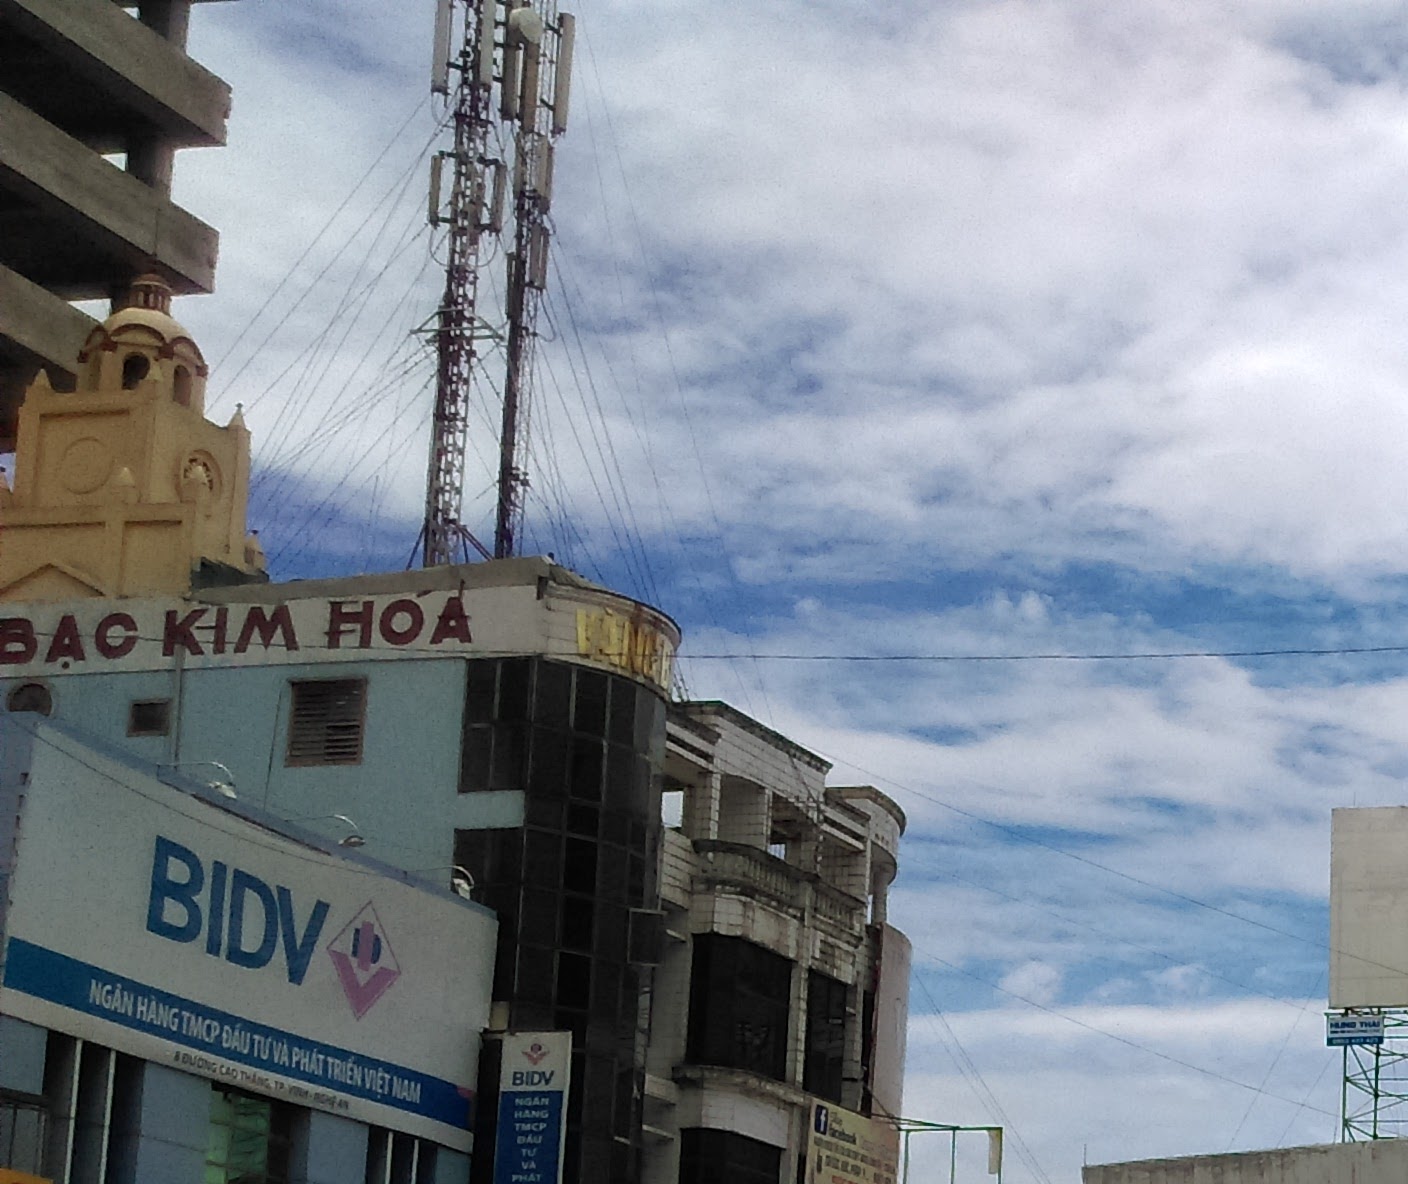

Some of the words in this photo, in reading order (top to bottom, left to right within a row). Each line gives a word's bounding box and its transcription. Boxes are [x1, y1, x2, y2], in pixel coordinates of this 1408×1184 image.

[162, 605, 298, 657] KIM
[145, 835, 331, 985] BIDV
[89, 979, 133, 1018] NGÂN
[136, 995, 178, 1032] HÀNG
[181, 1010, 220, 1044] TMCP
[252, 1034, 271, 1061] TƯ
[272, 1037, 290, 1066] VÀ
[291, 1046, 325, 1078] PHÁT
[363, 1065, 391, 1098] VIỆT
[393, 1077, 421, 1103] NAM
[220, 1064, 238, 1079] CAO
[512, 1071, 554, 1086] BIDV
